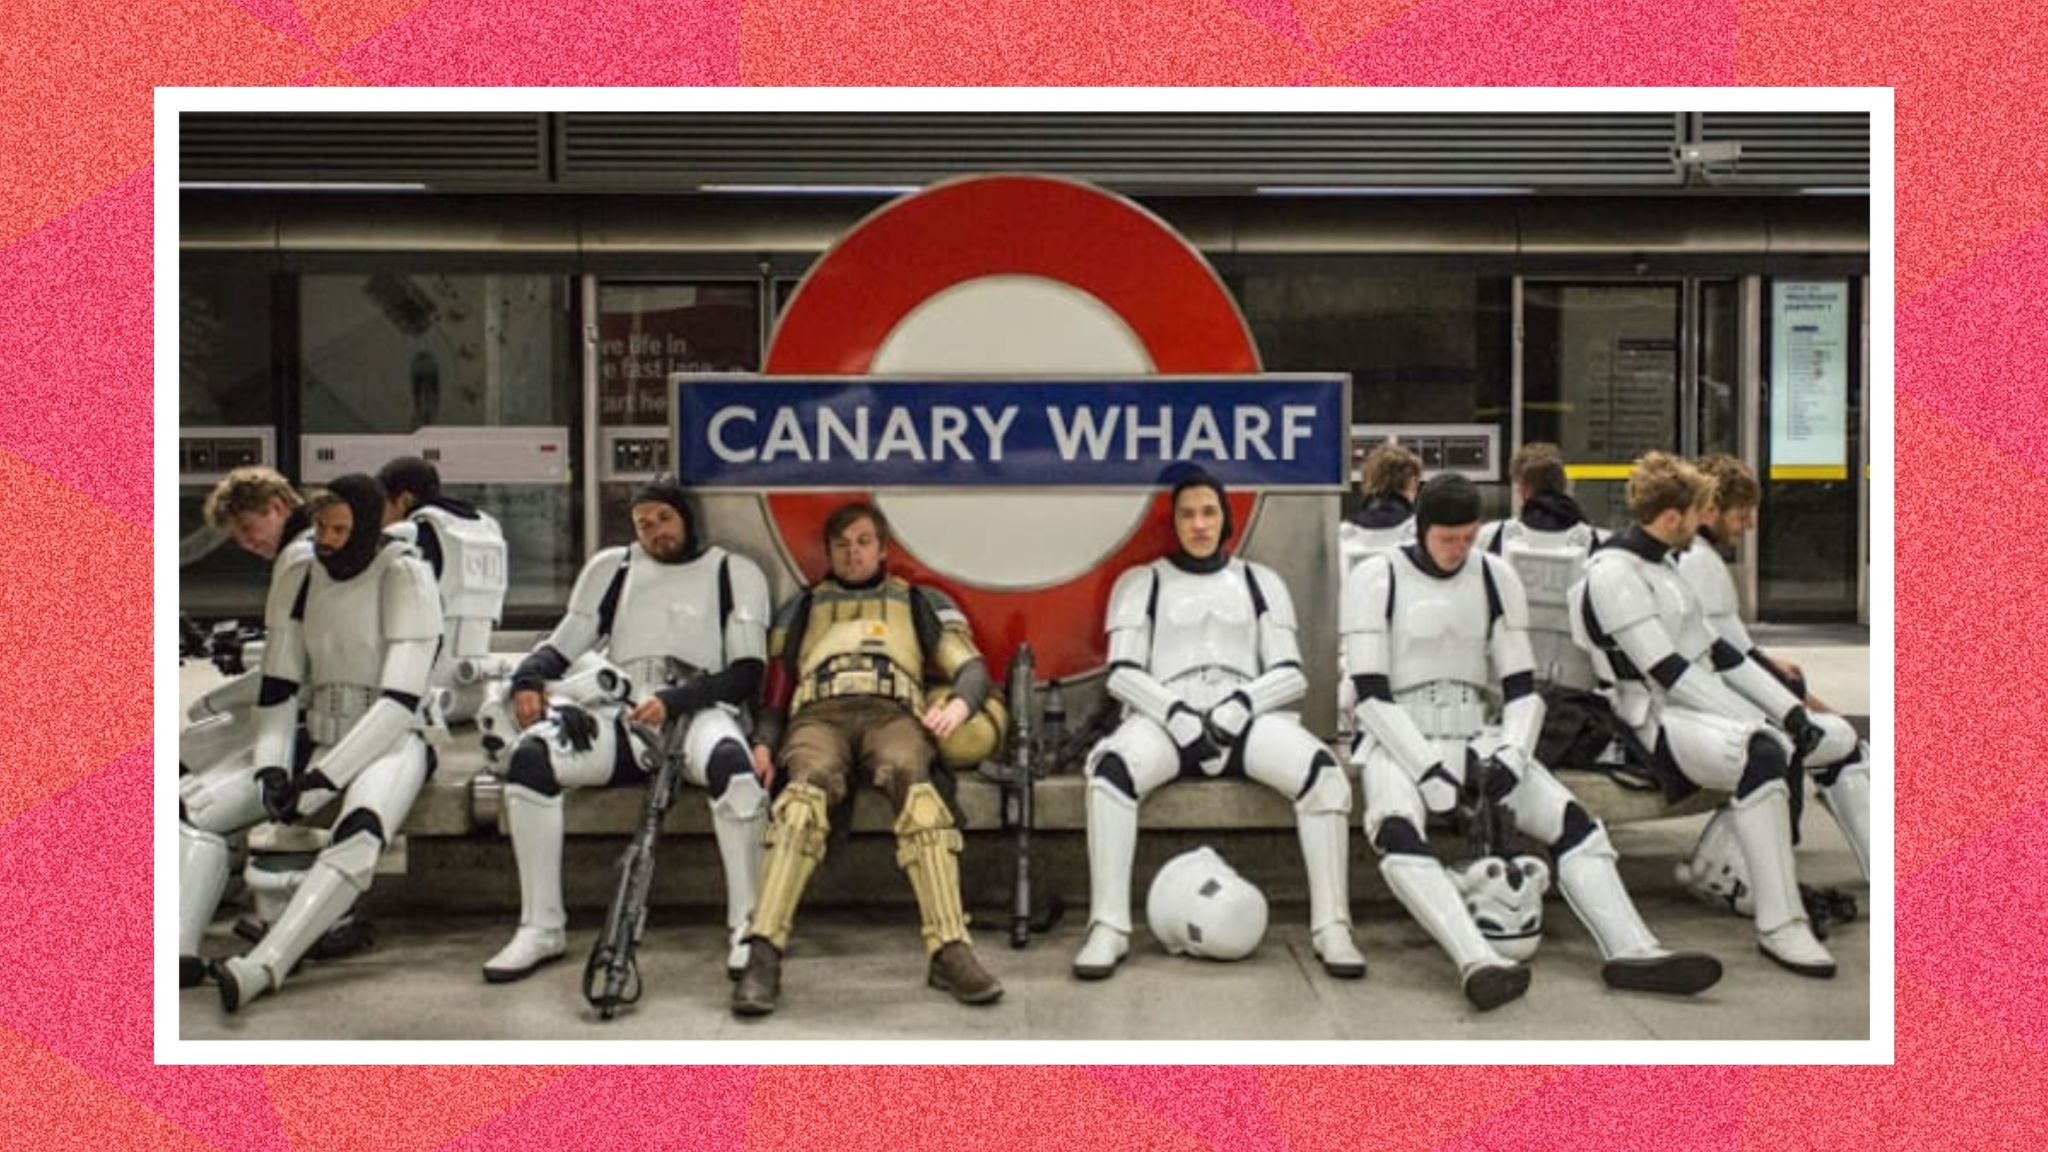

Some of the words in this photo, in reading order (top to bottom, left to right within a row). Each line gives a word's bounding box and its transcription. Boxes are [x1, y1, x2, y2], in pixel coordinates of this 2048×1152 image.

[629, 332, 662, 355] life
[666, 333, 688, 354] in
[620, 356, 664, 378] fast
[707, 406, 1019, 463] CANARY
[1046, 406, 1317, 461] WHARF
